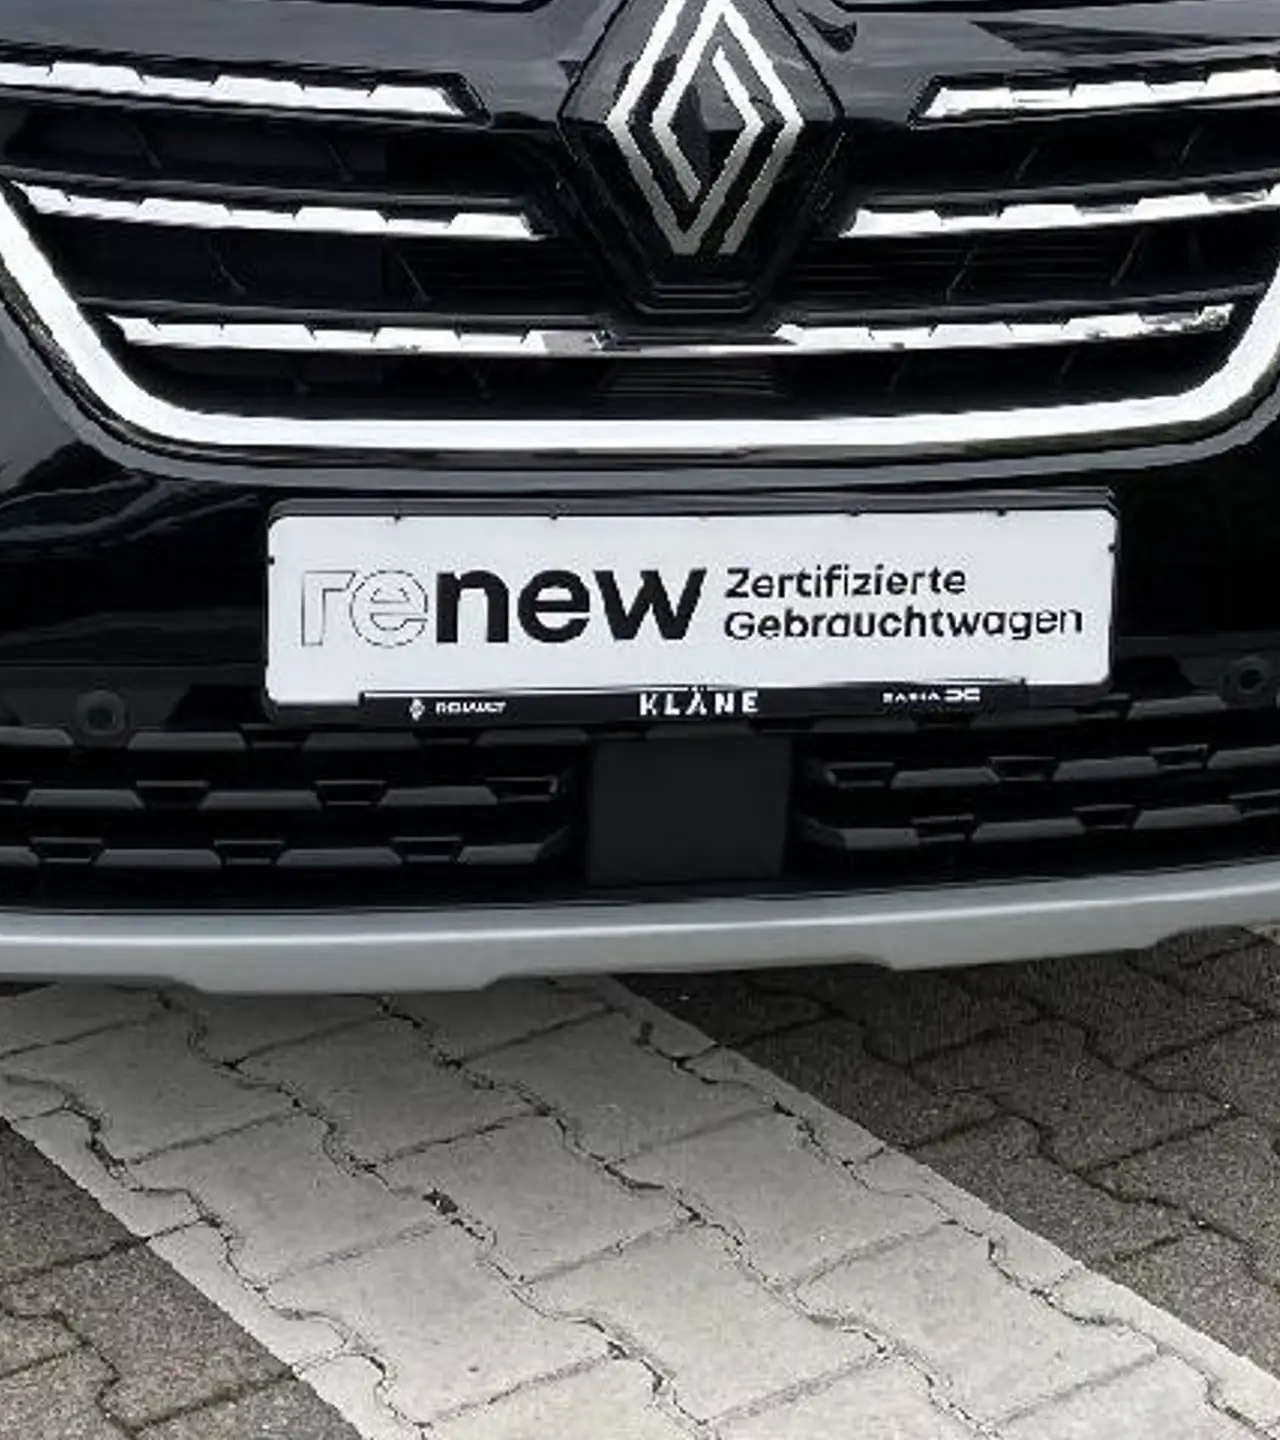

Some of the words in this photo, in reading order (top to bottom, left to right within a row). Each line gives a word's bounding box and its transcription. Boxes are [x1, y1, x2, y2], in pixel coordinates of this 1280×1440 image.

[724, 564, 966, 598] Zertifizierte
[301, 569, 707, 648] renew
[723, 605, 1083, 640] Gebrauchtwagen
[639, 685, 759, 716] KLÄNE
